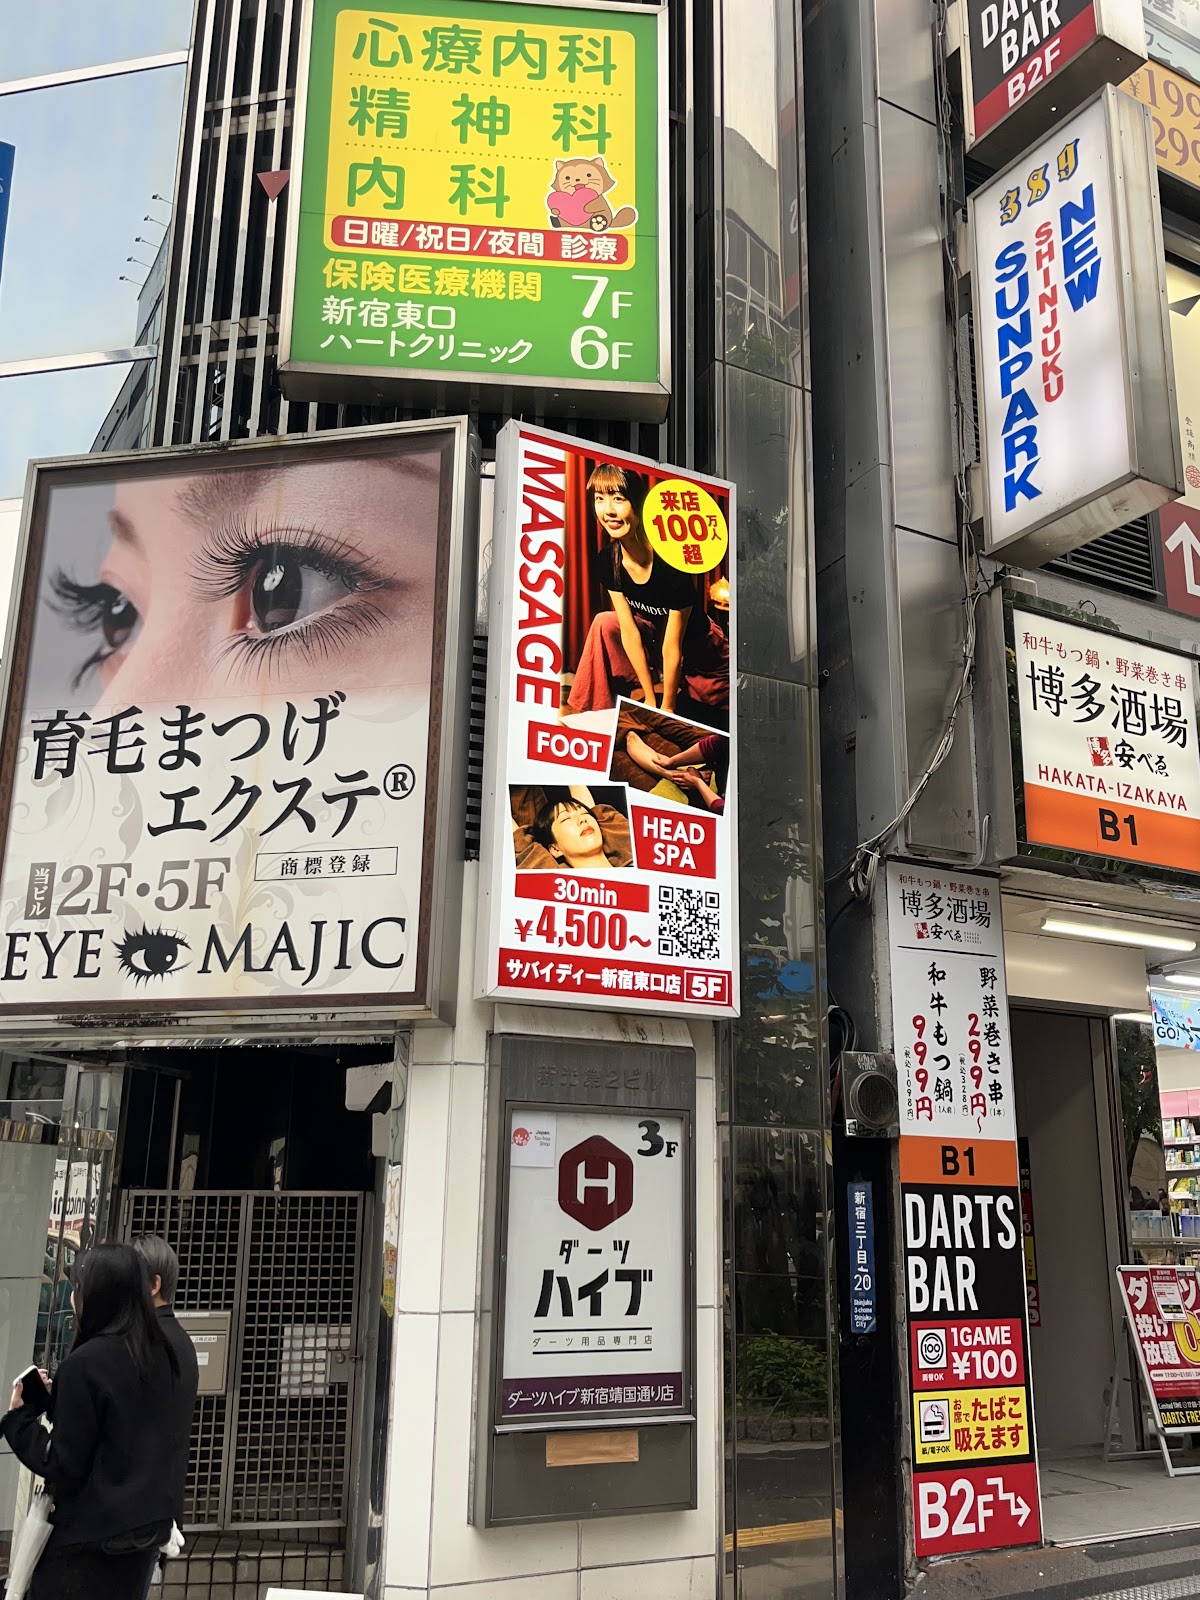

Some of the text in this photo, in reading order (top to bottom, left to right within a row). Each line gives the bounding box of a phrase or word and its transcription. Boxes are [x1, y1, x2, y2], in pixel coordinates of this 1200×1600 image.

[352, 18, 618, 86] 心療内科
[1001, 0, 1061, 74] BAR
[1007, 38, 1061, 108] B2F
[348, 85, 612, 154] 精神科
[347, 157, 510, 218] 内科
[1000, 138, 1080, 227] 389
[343, 219, 618, 261] 日曜/祝日/夜間 診療
[1059, 183, 1101, 313] NEW
[323, 258, 542, 302] 保険医療機関
[571, 274, 633, 319] 7F
[321, 296, 456, 331] 新宿東口
[1034, 221, 1064, 403] SHINJUKU
[320, 330, 533, 364] ハートクリニック
[570, 325, 633, 370] 6F
[994, 240, 1042, 513] SUNPARK
[659, 491, 700, 512] 来店
[683, 544, 704, 565] 超
[516, 450, 565, 709] MASSAGE
[1022, 632, 1187, 692] 和牛もつ鍋・野菜巻き串
[1025, 660, 1188, 749] 博多酒場
[31, 691, 346, 780] 育毛まつげ
[537, 730, 603, 763] FOOT
[1038, 764, 1187, 811] HAKATA-IZAKAYA
[642, 815, 705, 845] HEAD
[1098, 808, 1138, 846] B1
[280, 853, 371, 876] 商標登録
[653, 843, 696, 870] SPA
[29, 867, 50, 917] 当ビル
[553, 877, 618, 906] 30min
[899, 889, 991, 928] 博多酒場
[0, 917, 407, 986] EYE MAJIC
[506, 959, 723, 999] サバイディー新宿東口店 5F
[928, 961, 953, 1103] 和牛もつ鍋
[979, 967, 1004, 1105] 野菜巻き串
[1156, 1026, 1180, 1041] GO!
[912, 1014, 933, 1122] 999円
[637, 1119, 678, 1158] 3F
[941, 1145, 975, 1176] B1
[854, 1191, 867, 1264] 新宿三丁目
[904, 1193, 1017, 1250] DARTS
[559, 1239, 630, 1265] ダーツ
[534, 1268, 653, 1317] ハイブ
[853, 1274, 872, 1291] 20
[907, 1255, 979, 1313] BAR
[1127, 1276, 1196, 1310] ダツ
[532, 1335, 653, 1347] ダーツ用品専門店
[950, 1325, 1012, 1346] 1GAME
[1142, 1341, 1181, 1365] 放題
[951, 1349, 1017, 1381] ¥100
[507, 1384, 674, 1408] ダーツハイブ新宿靖国通り店
[1161, 1411, 1186, 1425] DARTS
[954, 1423, 1024, 1452] 吸えます
[918, 1478, 994, 1539] B2F
